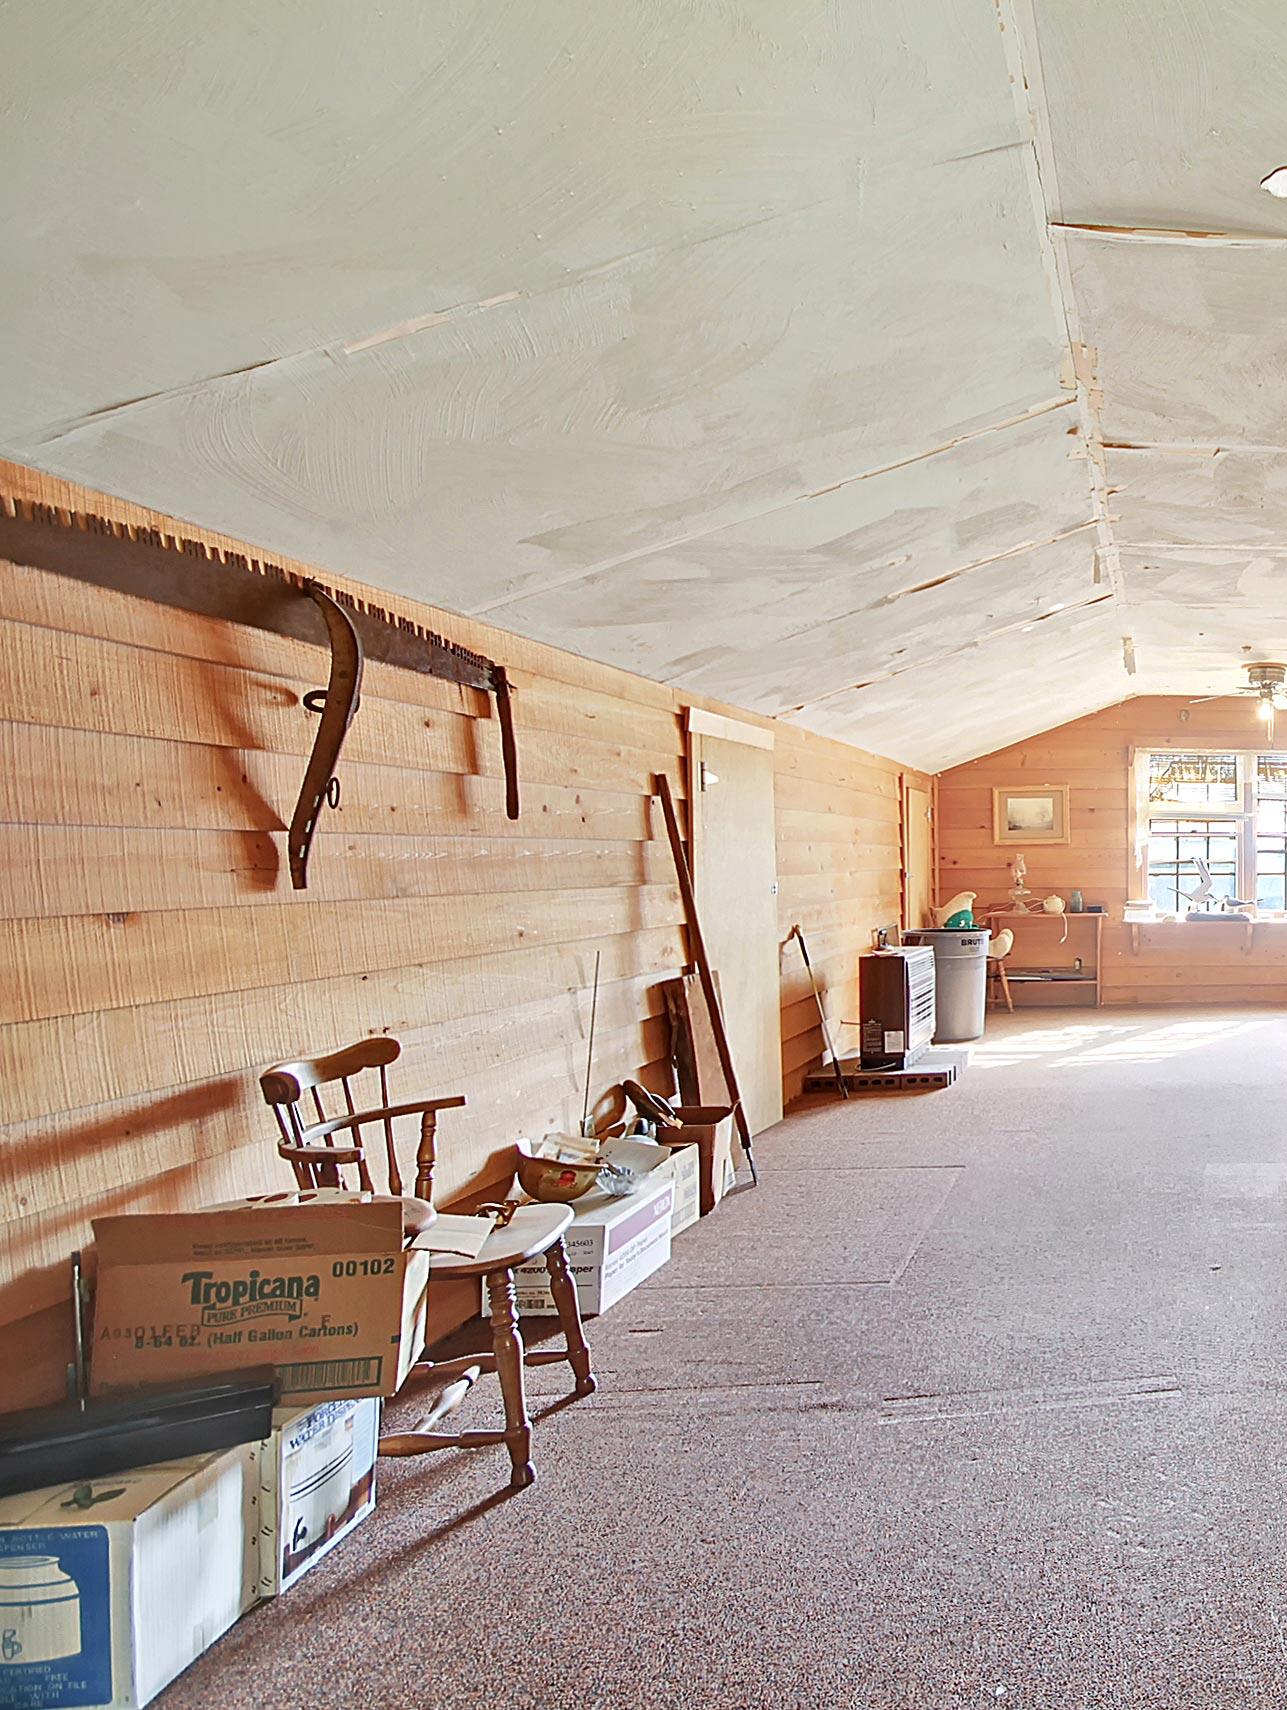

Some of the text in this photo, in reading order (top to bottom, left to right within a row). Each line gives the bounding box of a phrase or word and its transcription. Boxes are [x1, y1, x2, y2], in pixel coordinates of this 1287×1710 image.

[332, 1258, 395, 1278] 00102
[570, 1266, 594, 1275] aper
[181, 1269, 320, 1306] Tropicana
[240, 1300, 298, 1318] PREMIUM
[207, 1331, 242, 1348] (Half
[248, 1329, 293, 1343] Gallon
[299, 1321, 359, 1338] Cartons)
[60, 1530, 98, 1540] WATER
